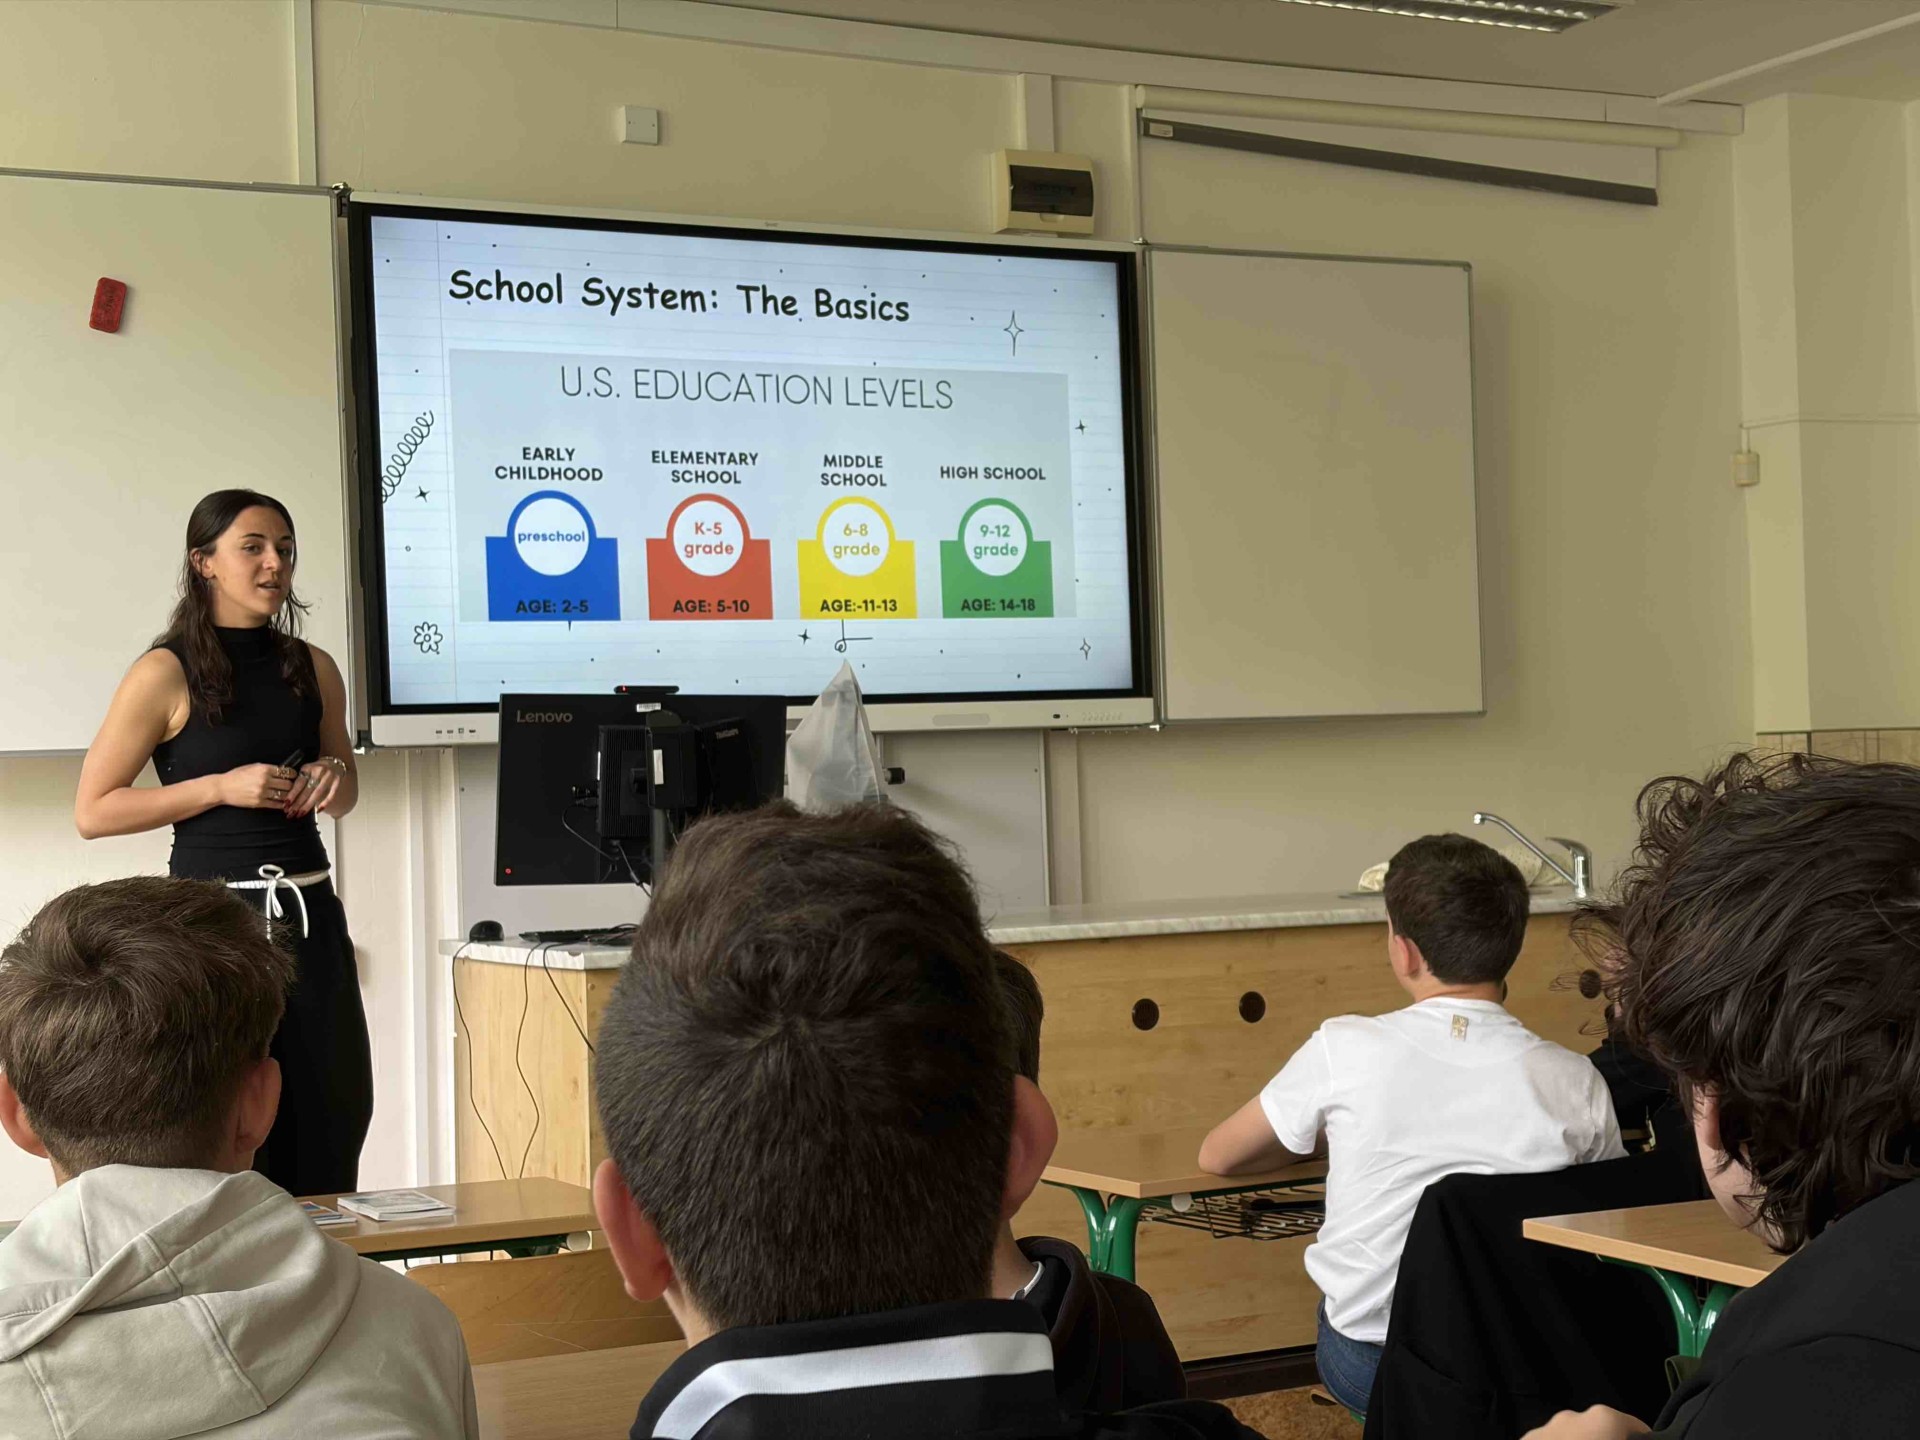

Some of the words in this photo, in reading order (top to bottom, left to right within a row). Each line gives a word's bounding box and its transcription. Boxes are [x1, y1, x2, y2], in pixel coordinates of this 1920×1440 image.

[449, 268, 563, 304] School
[581, 277, 718, 316] System:
[736, 284, 798, 316] The
[815, 288, 910, 322] Basics
[561, 365, 620, 399] U.S.
[634, 369, 832, 405] EDUCATION
[845, 376, 953, 410] LEVELS
[522, 446, 576, 462] EARLY
[651, 450, 759, 466] ELEMENTARY
[823, 454, 883, 469] MIDDLE
[495, 466, 603, 482] CHILDHOOD
[671, 470, 741, 485] SCHOOL
[820, 473, 887, 487] SCHOOL
[940, 466, 978, 480] HIGH
[983, 467, 1046, 481] SCHOOL
[694, 522, 723, 536] K-5
[843, 523, 868, 537] 6-8
[980, 525, 1011, 538] 9-12
[518, 530, 586, 545] preschool
[684, 541, 734, 558] grade
[833, 543, 880, 559] grade
[973, 543, 1018, 559] grade
[515, 600, 556, 614] AGE:
[562, 600, 589, 614] 2-5
[673, 600, 711, 613] AGE:
[717, 600, 749, 613] 5-10
[960, 598, 995, 612] AGE:
[1000, 598, 1036, 612] 14-18
[516, 709, 573, 723] Lenovo
